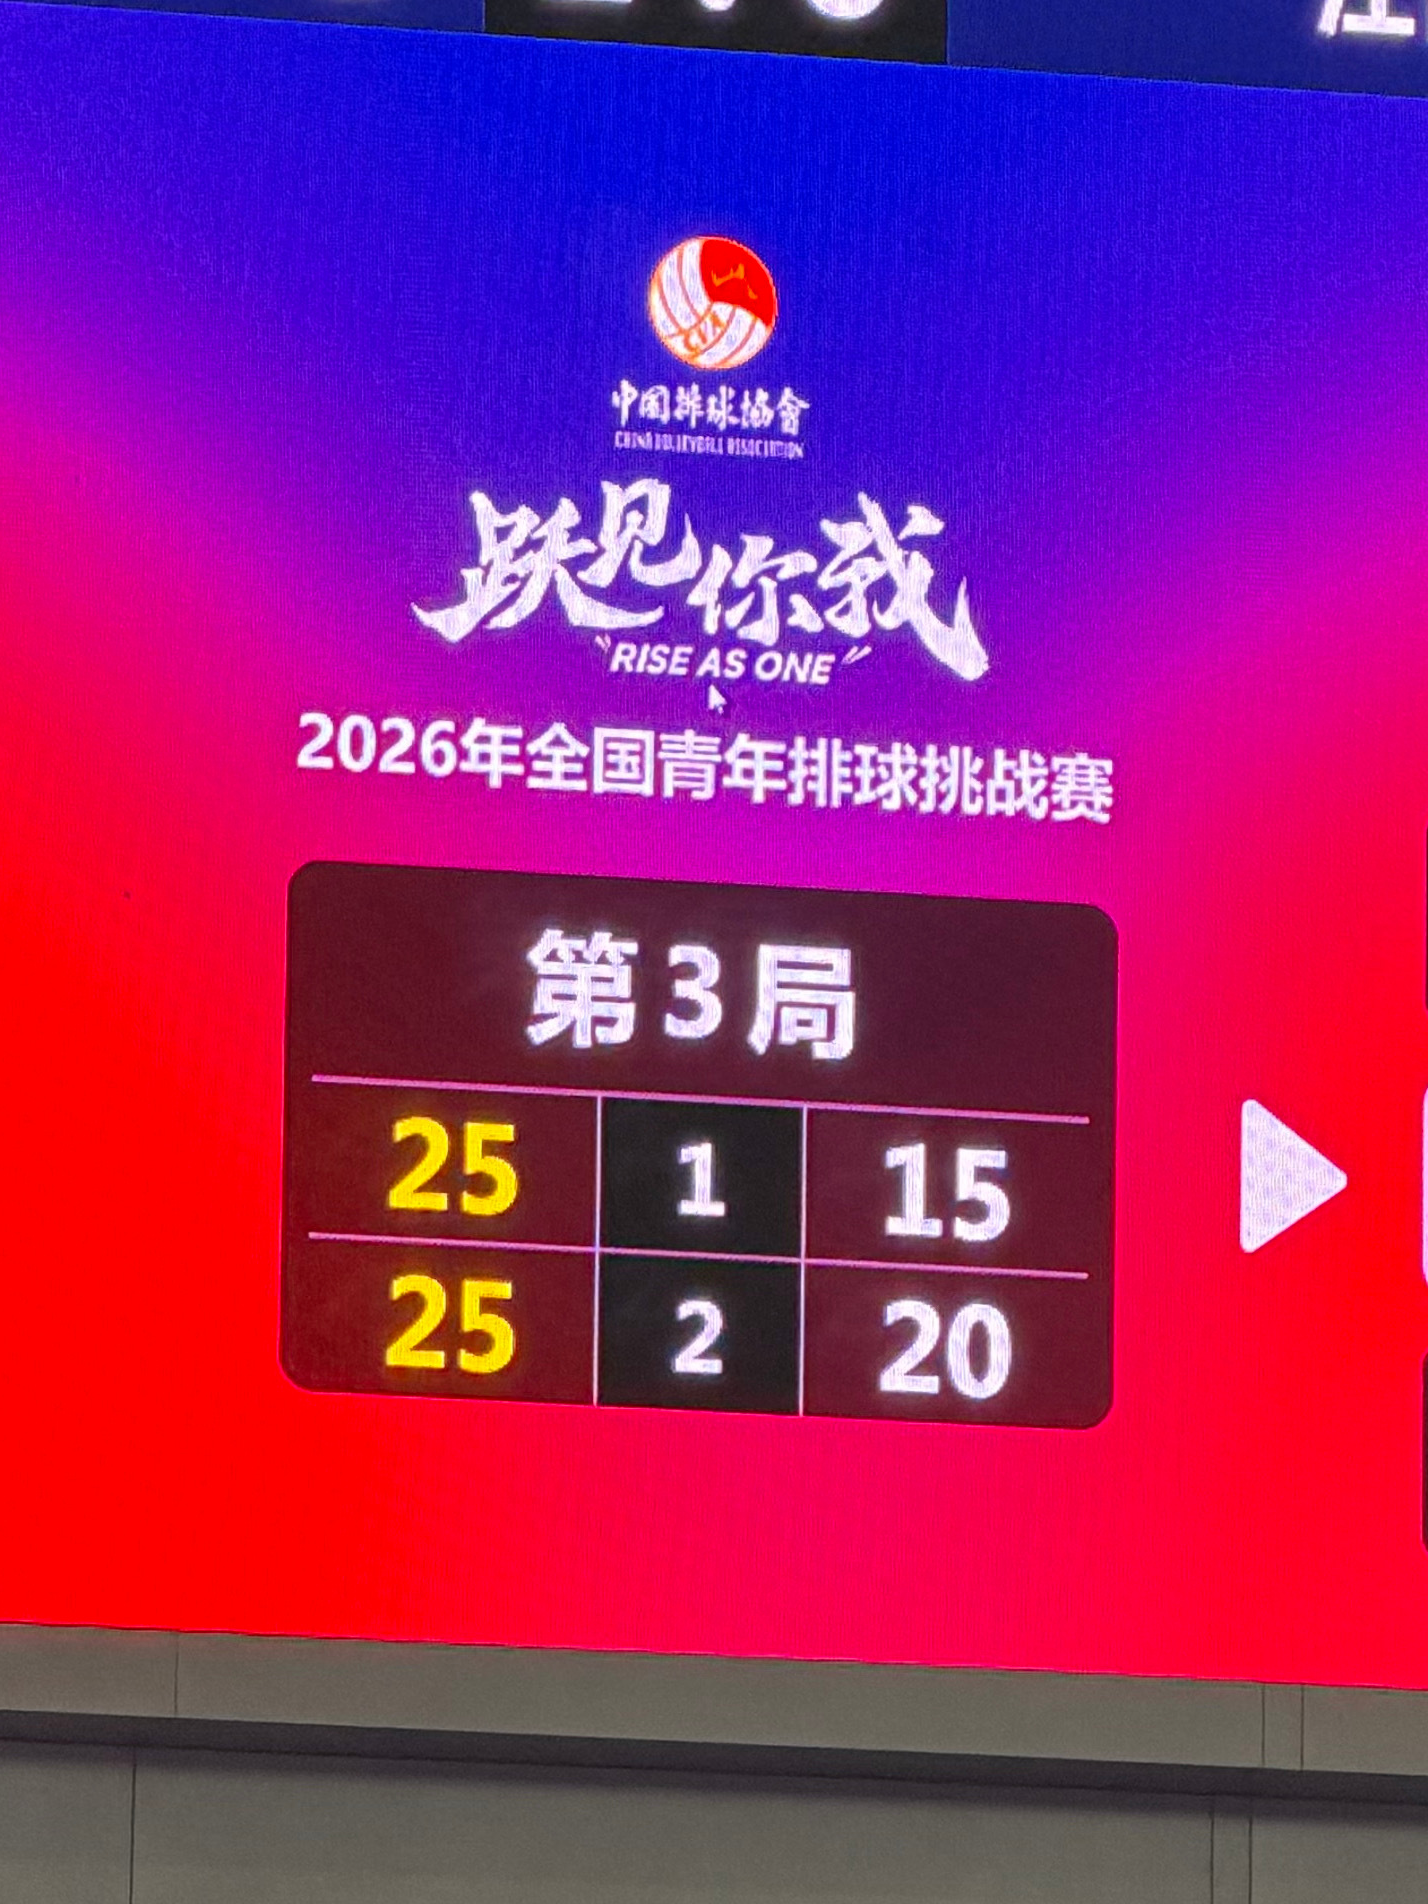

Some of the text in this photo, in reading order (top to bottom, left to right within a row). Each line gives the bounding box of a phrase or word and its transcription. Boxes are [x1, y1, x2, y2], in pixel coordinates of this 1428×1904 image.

[412, 478, 989, 681] 跃见你我
[696, 647, 753, 679] AS
[297, 712, 1114, 824] 2026年全国青年排球挑战赛
[388, 1115, 519, 1216] 25
[677, 1141, 727, 1217] 1
[883, 1142, 1011, 1243] 15
[384, 1273, 516, 1374] 25
[672, 1298, 724, 1375] 2
[878, 1298, 1013, 1400] 20
